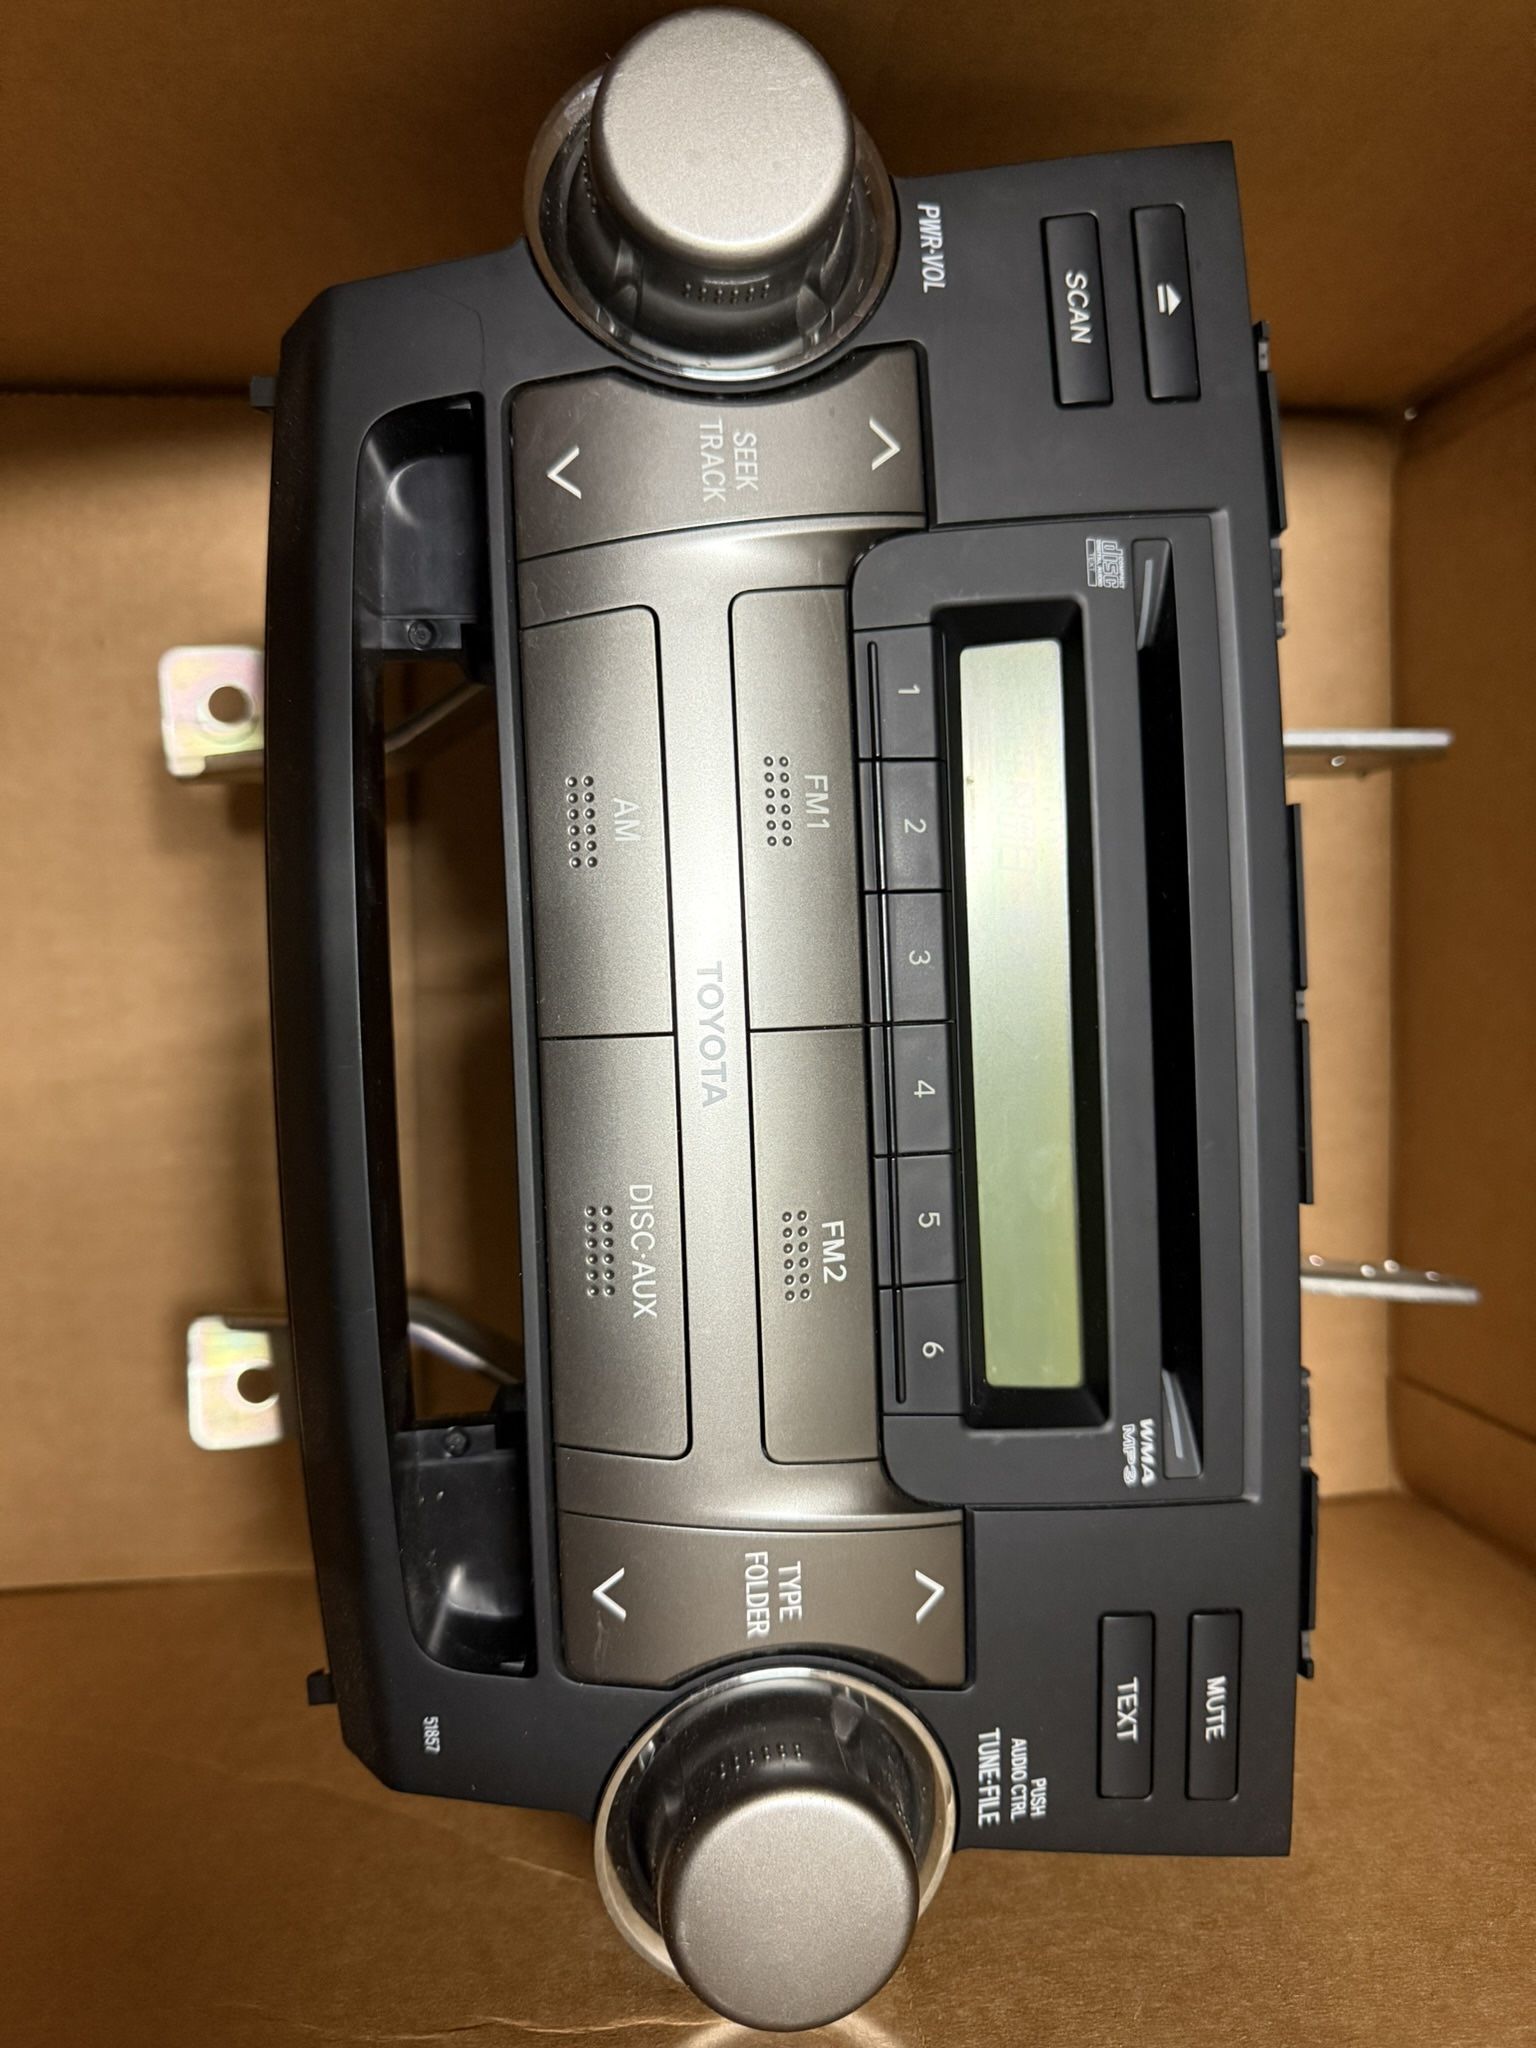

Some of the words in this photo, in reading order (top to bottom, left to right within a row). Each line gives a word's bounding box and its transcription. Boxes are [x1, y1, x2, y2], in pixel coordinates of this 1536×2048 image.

[1064, 269, 1093, 344] SCAN
[699, 416, 726, 503] TRACK
[733, 431, 759, 492] SEEK
[897, 683, 921, 696] 1
[612, 797, 642, 843] AM
[804, 774, 831, 830] FM1
[903, 817, 927, 835] 2
[908, 949, 932, 966] 3
[696, 960, 729, 1109] TOYOTA
[913, 1079, 936, 1098] 4
[918, 1211, 941, 1229] 5
[821, 1219, 848, 1284] FM2
[921, 1340, 945, 1359] 6
[1122, 1423, 1138, 1488] MP3
[1138, 1418, 1156, 1488] WMA
[744, 1550, 771, 1640] FOLDER
[777, 1559, 803, 1624] TYPE
[423, 1715, 441, 1755] 51857
[1116, 1676, 1140, 1744] TEXT
[1205, 1675, 1227, 1743] MUTE
[1010, 1737, 1028, 1781] AUDIO
[1010, 1783, 1027, 1823] CTRL
[1030, 1776, 1047, 1818] PUSH
